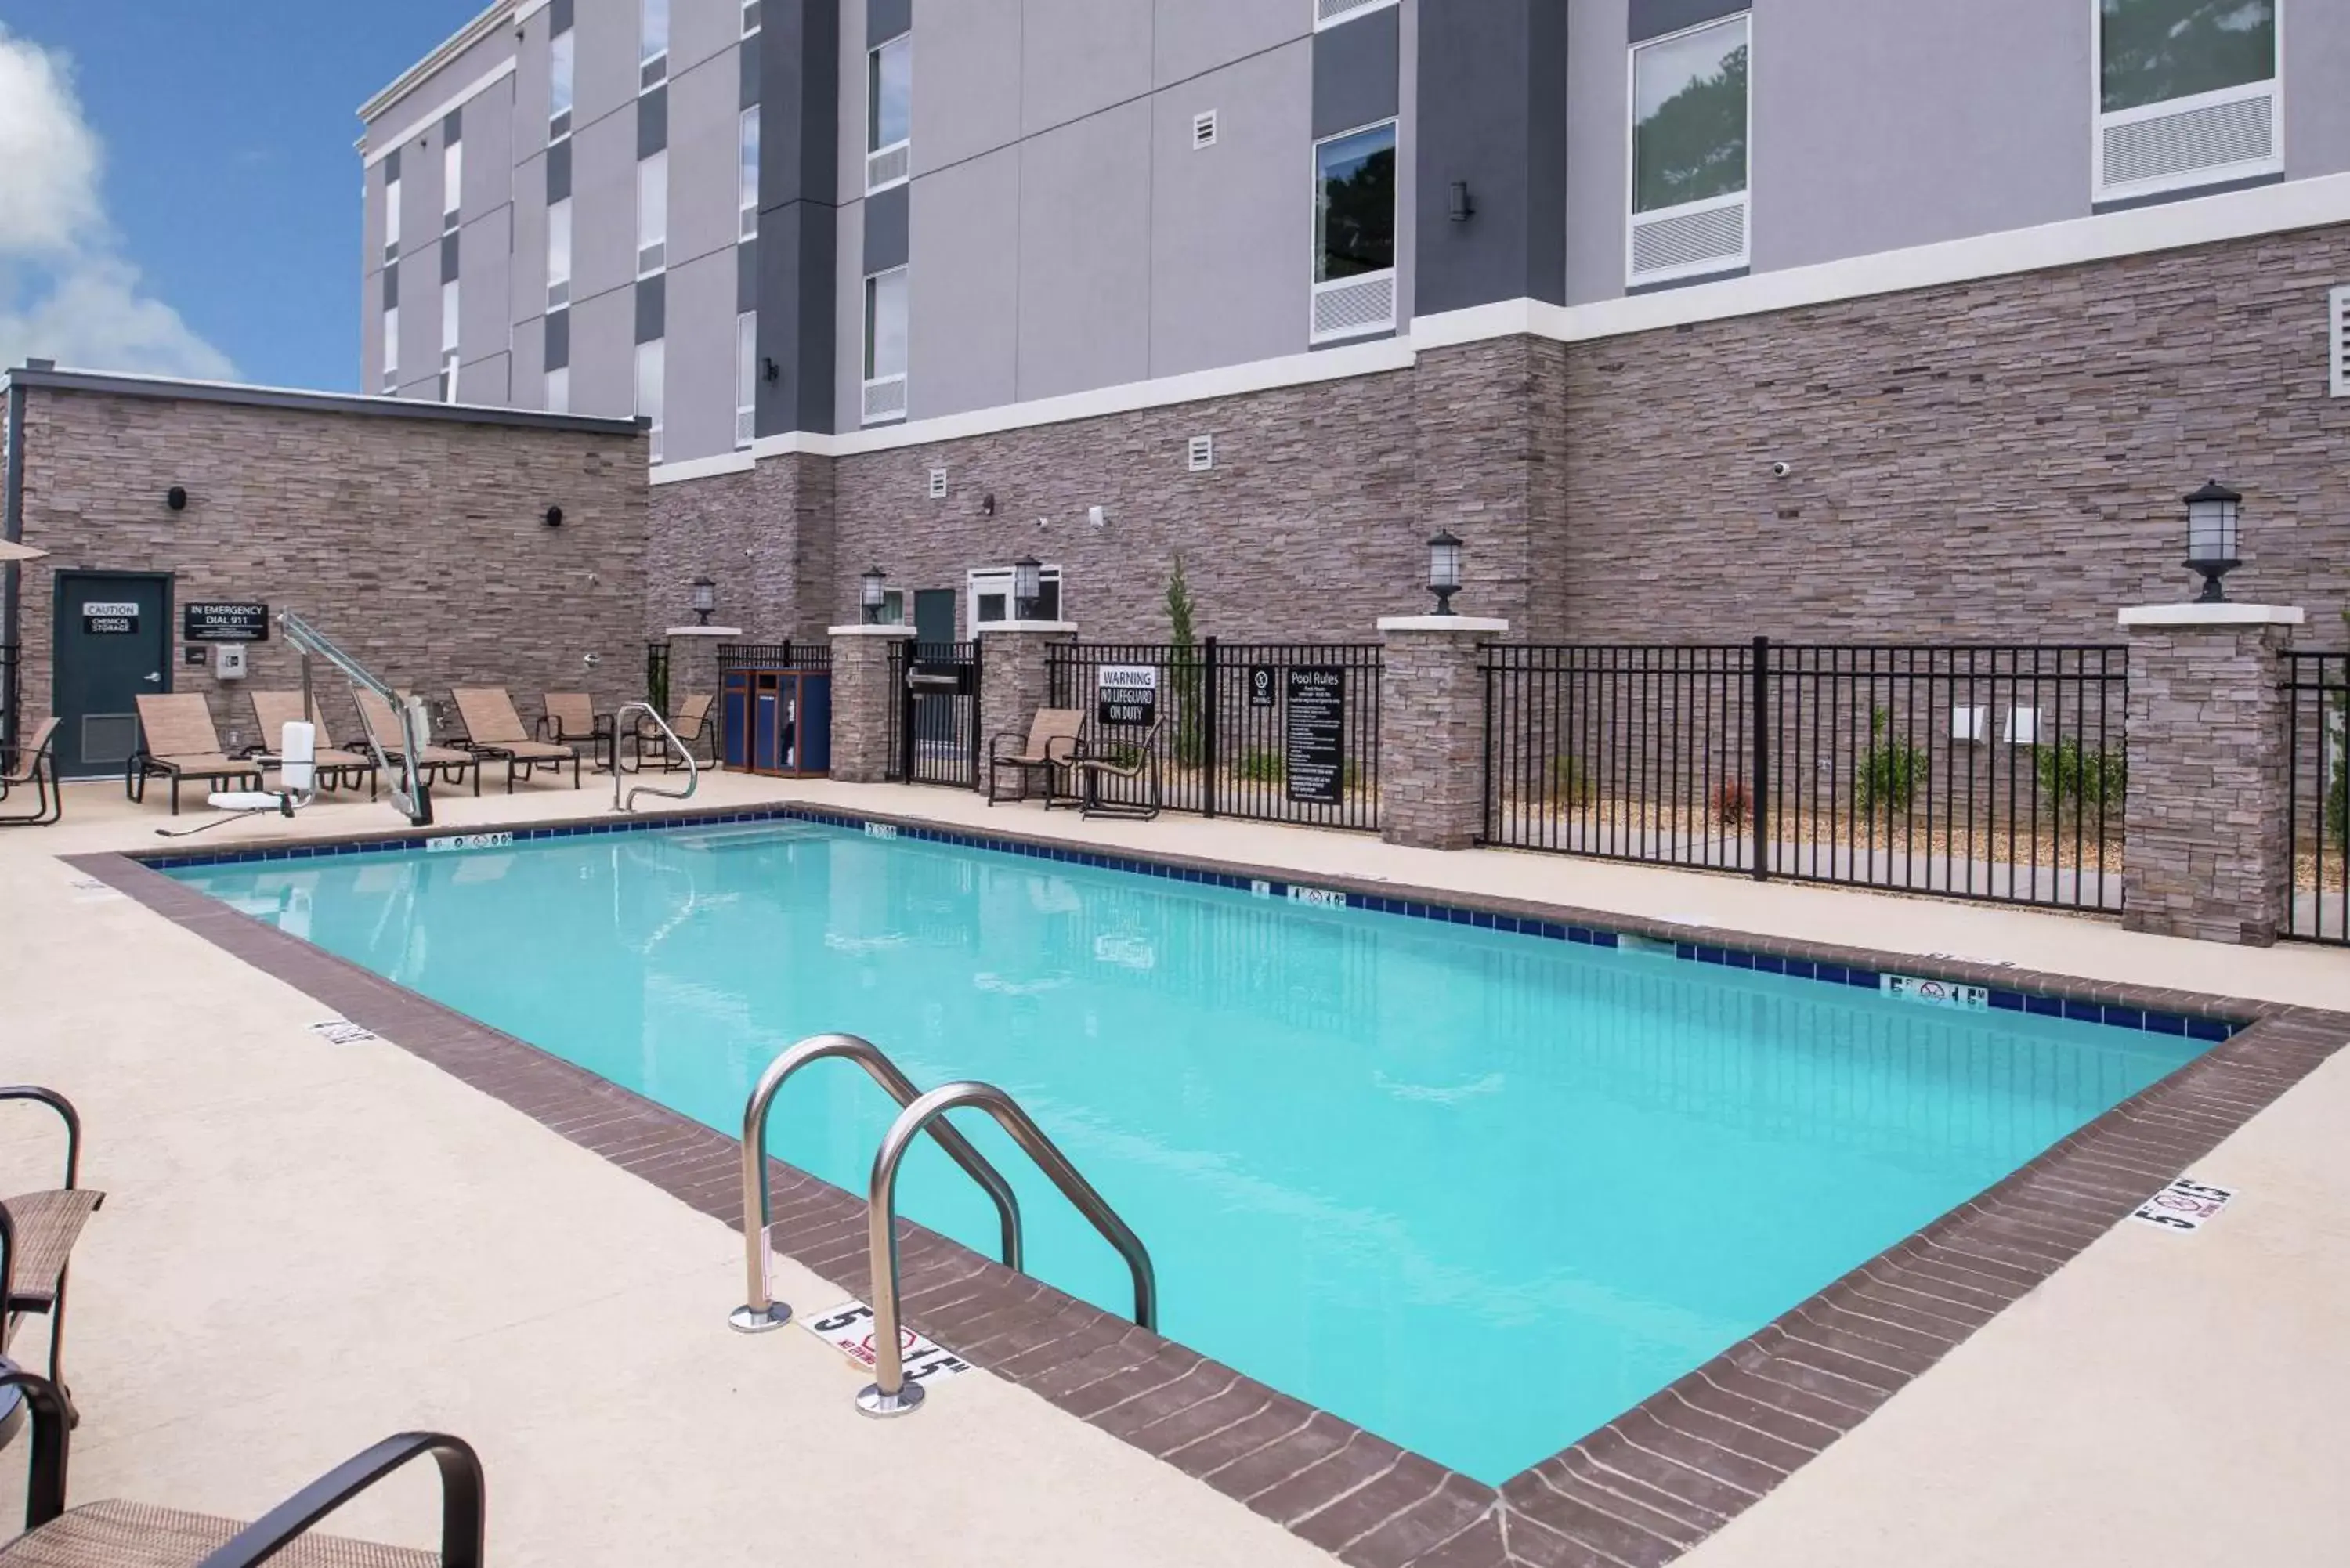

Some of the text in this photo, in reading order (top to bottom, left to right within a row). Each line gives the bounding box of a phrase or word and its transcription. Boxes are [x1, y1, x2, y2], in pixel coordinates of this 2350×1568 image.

[88, 605, 134, 615] CAUTION
[190, 605, 262, 615] IN EMERGENCY
[206, 616, 230, 624] DIAL
[1104, 671, 1151, 685] WARNING
[1292, 670, 1339, 685] Pool Rules
[1101, 688, 1152, 704] NO LIFEGUARD
[1110, 706, 1143, 720] ON DUTY
[2135, 1210, 2196, 1228] 5
[814, 1306, 873, 1331] 5
